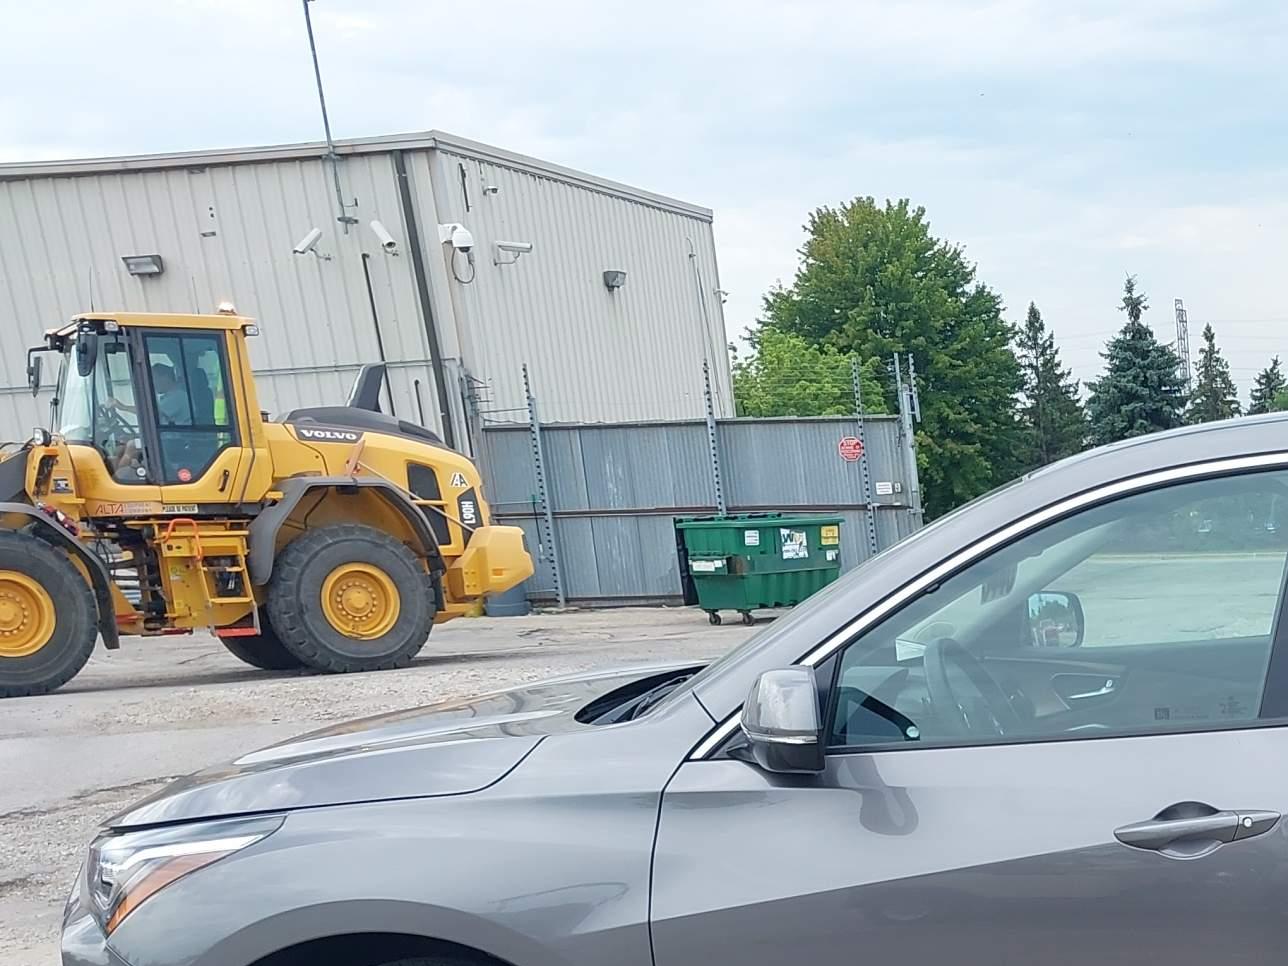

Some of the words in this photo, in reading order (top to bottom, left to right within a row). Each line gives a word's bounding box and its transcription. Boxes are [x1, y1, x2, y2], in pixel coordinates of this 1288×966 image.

[300, 429, 358, 441] VOLVO
[95, 503, 124, 515] ALTA
[460, 500, 477, 525] L90H
